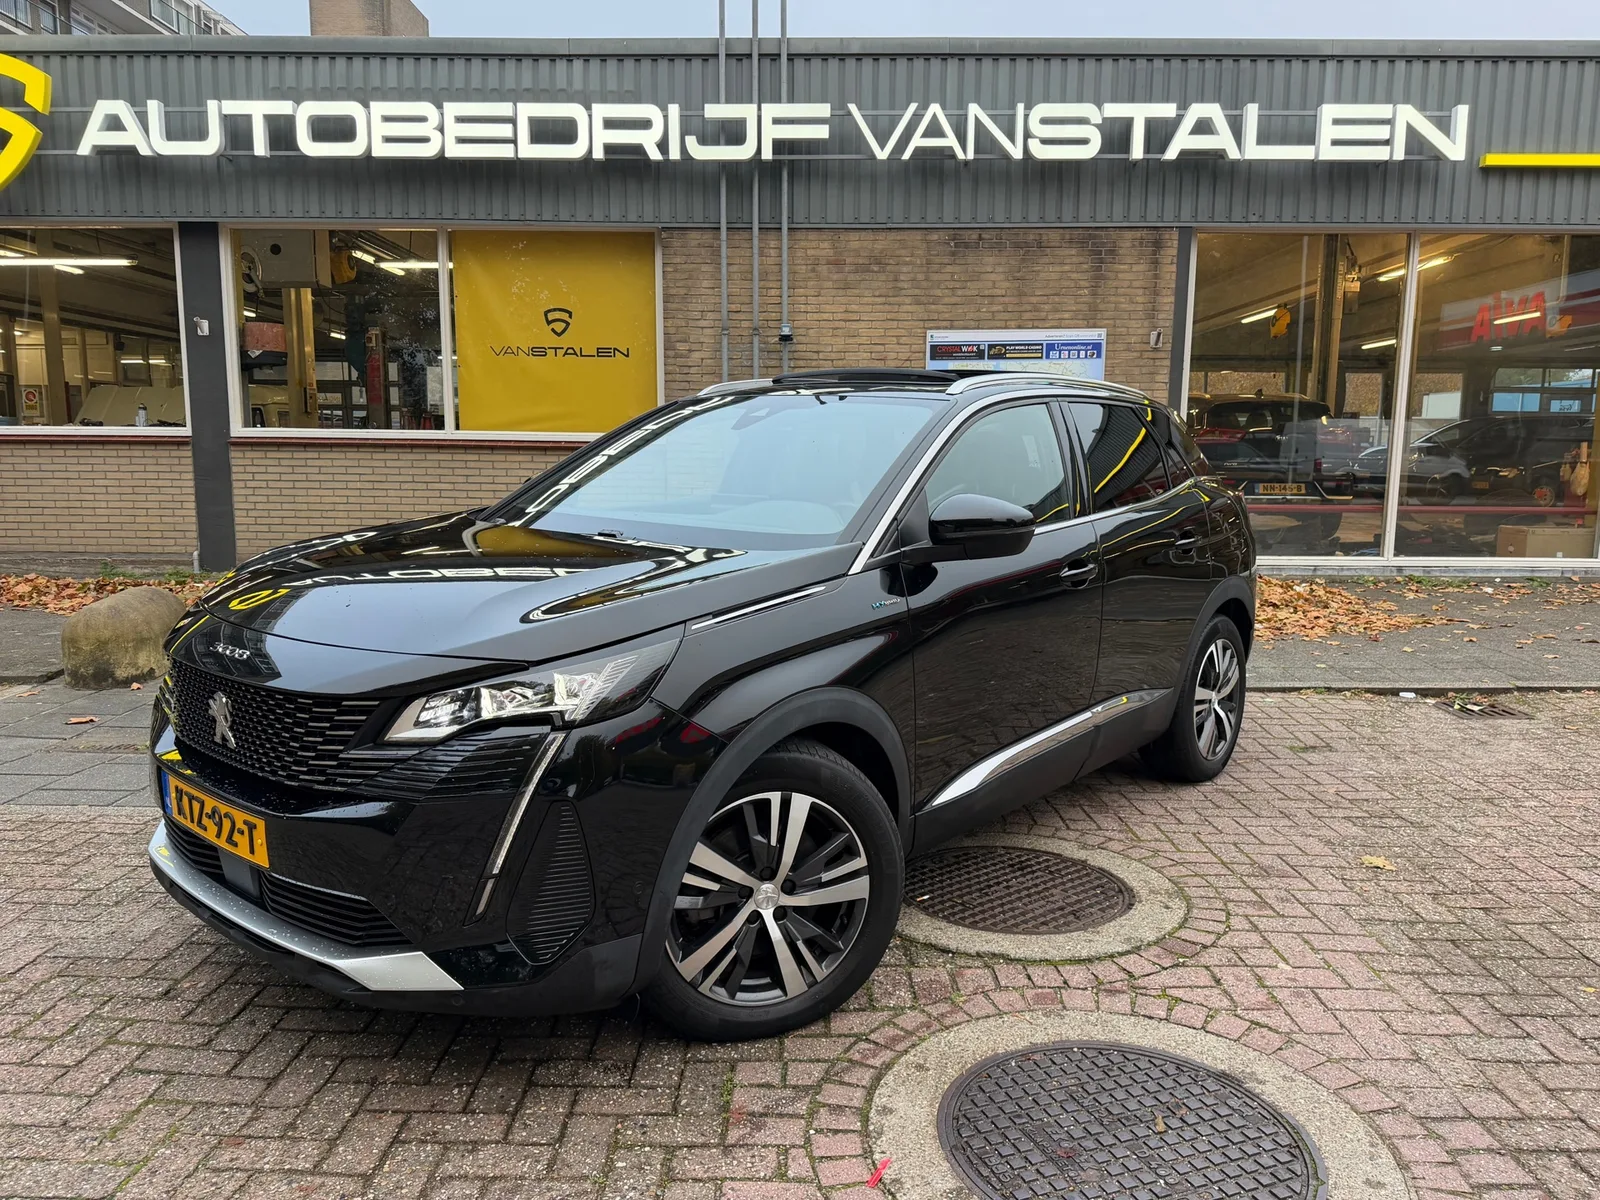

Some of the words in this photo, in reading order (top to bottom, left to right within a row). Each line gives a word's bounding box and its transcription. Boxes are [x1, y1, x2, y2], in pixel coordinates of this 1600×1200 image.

[76, 99, 831, 162] AUTOBEDRIJF
[490, 345, 630, 358] VANSTALEN
[209, 641, 250, 660] 3008
[174, 784, 258, 856] KTZ-92-T
